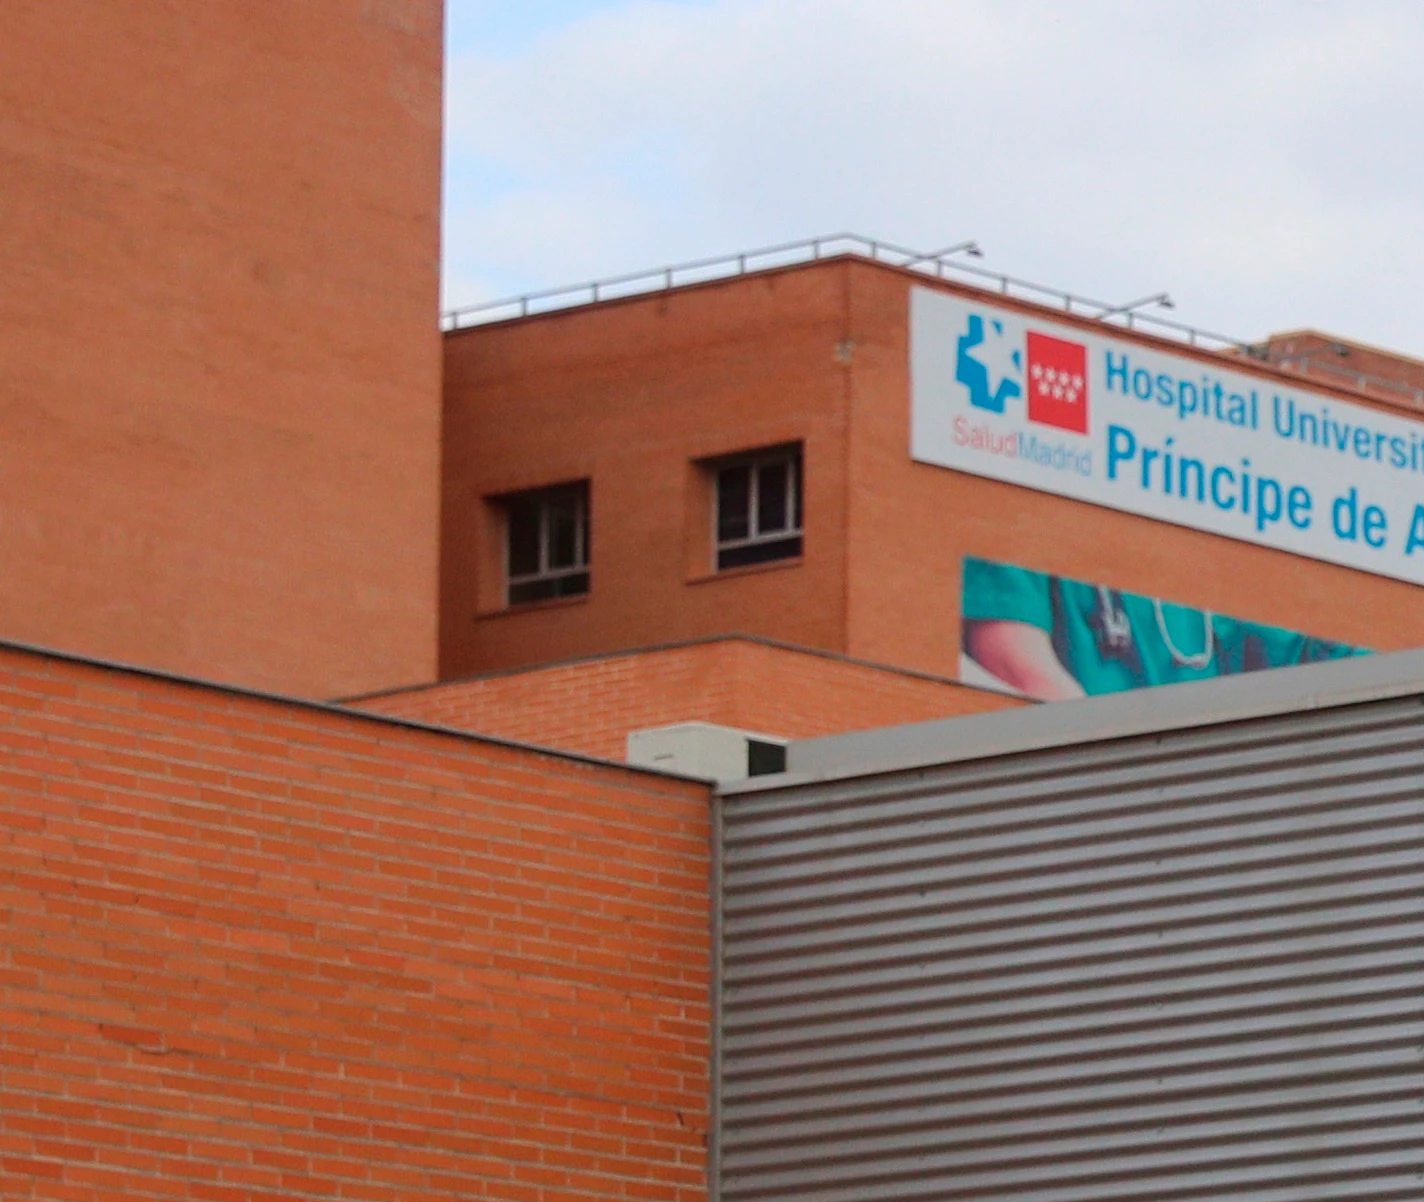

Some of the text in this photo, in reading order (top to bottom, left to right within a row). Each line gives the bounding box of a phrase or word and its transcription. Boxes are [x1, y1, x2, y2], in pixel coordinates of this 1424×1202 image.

[1105, 349, 1258, 430] Hospital
[954, 415, 1092, 476] SaludMadrid
[1107, 423, 1312, 532] Príncipe
[1332, 486, 1387, 548] de
